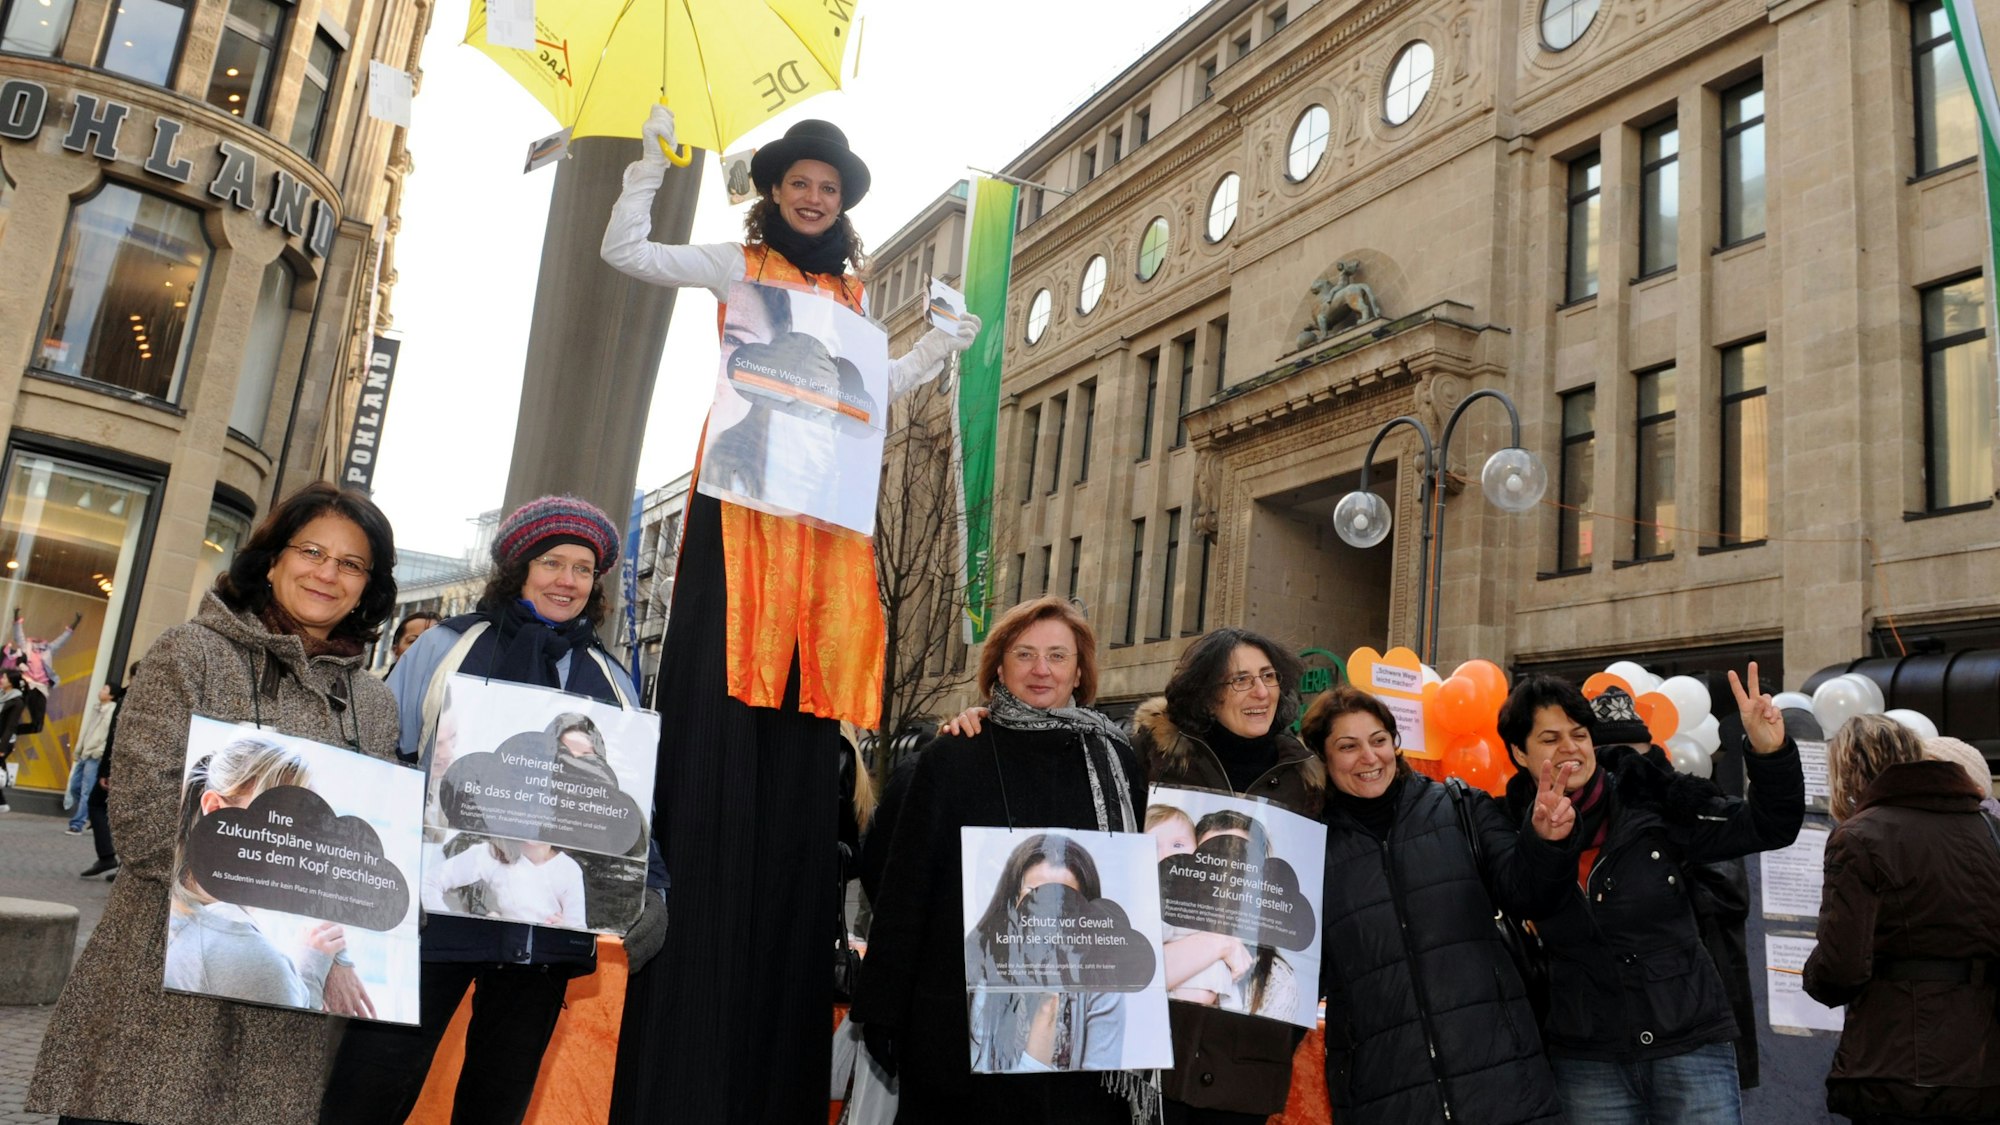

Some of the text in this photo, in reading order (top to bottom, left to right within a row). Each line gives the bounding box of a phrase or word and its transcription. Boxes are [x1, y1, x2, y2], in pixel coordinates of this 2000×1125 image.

[735, 357, 777, 376] Schwere
[780, 369, 807, 386] Wege
[809, 378, 833, 394] leicht
[347, 352, 392, 484] POHLAND
[501, 752, 564, 774] Verheiratet
[464, 781, 629, 820] Bis dass der Tod sie scheidet?
[525, 775, 610, 800] und verprügelt.
[268, 810, 293, 827] Ihre
[216, 820, 380, 867] Zukunftspläne wurden ihr
[237, 847, 400, 891] aus dem Kopf geschlagen.
[1195, 852, 1258, 873] Schon einen
[211, 869, 223, 879] Als
[223, 872, 254, 885] Studentin
[255, 877, 270, 886] wird
[270, 879, 280, 888] ihr
[279, 881, 293, 890] kein
[294, 884, 308, 893] Platz
[308, 887, 317, 895] im
[317, 888, 349, 902] Frauenhaus
[1169, 865, 1284, 896] Antrag auf gewaltfreie
[1212, 886, 1294, 914] Zukunft gestellt?
[1020, 915, 1114, 929] Schutz vor Gewalt
[995, 932, 1129, 946] kann sie sich nicht leisten.
